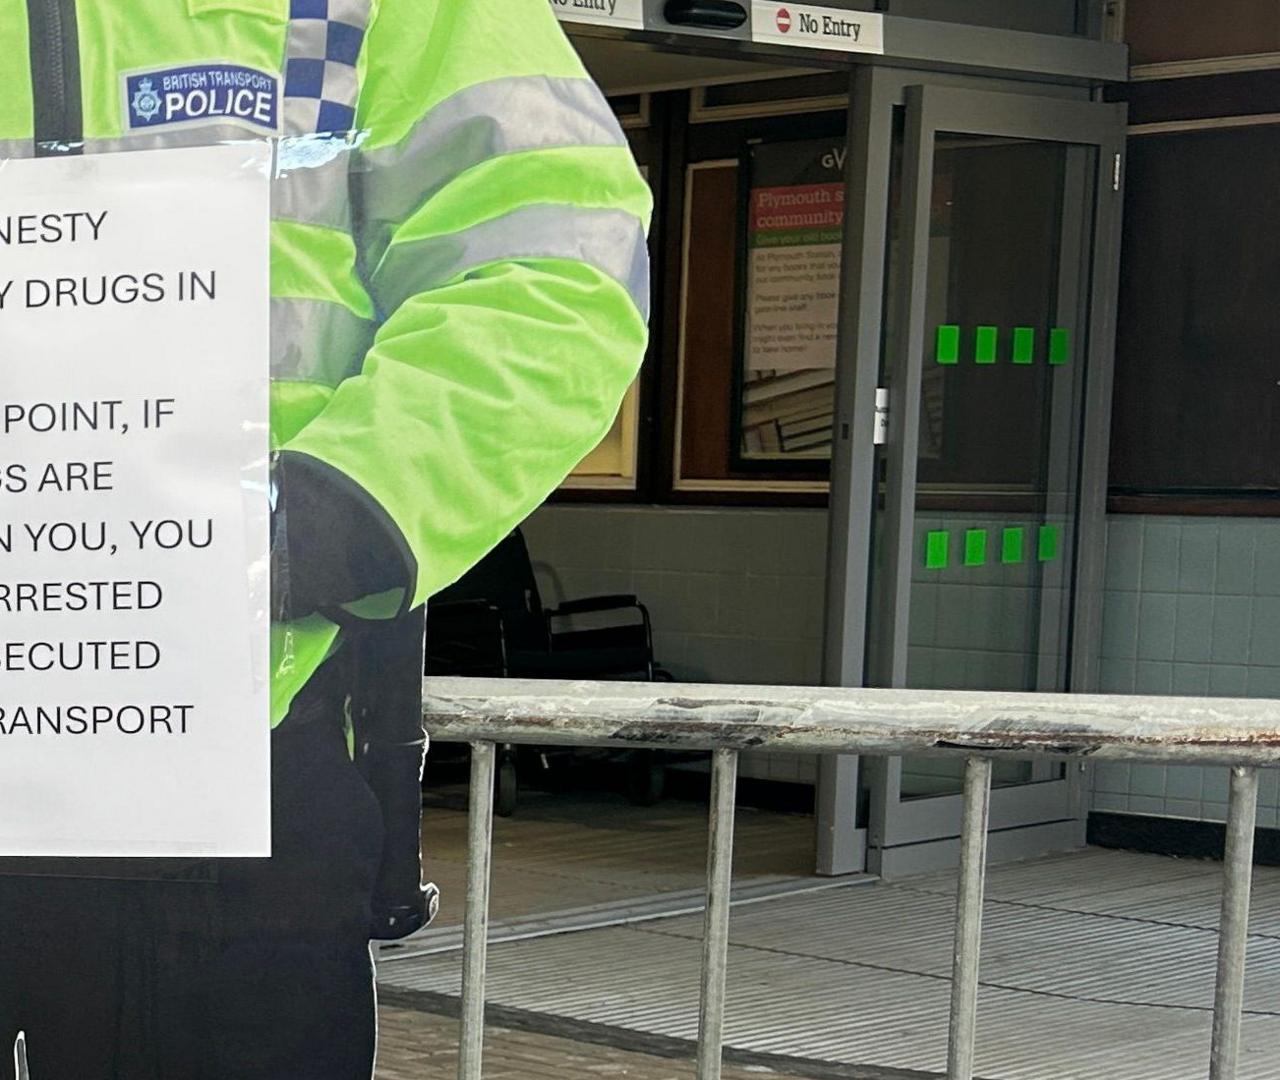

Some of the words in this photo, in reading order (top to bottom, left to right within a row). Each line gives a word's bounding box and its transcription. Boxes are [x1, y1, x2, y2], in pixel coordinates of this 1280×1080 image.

[799, 13, 818, 34] No
[822, 16, 861, 42] Entry
[162, 72, 207, 91] BRITISH
[208, 71, 272, 91] TRANSPORT
[165, 88, 273, 122] POLICE
[757, 190, 831, 208] Plymouth
[756, 210, 844, 228] community
[26, 273, 165, 308] DRUGS
[178, 270, 215, 301] IN
[4, 400, 129, 435] POINT,
[144, 398, 175, 429] IF
[37, 461, 113, 493] ARE
[23, 521, 117, 556] YOU,
[129, 518, 213, 550] YOU
